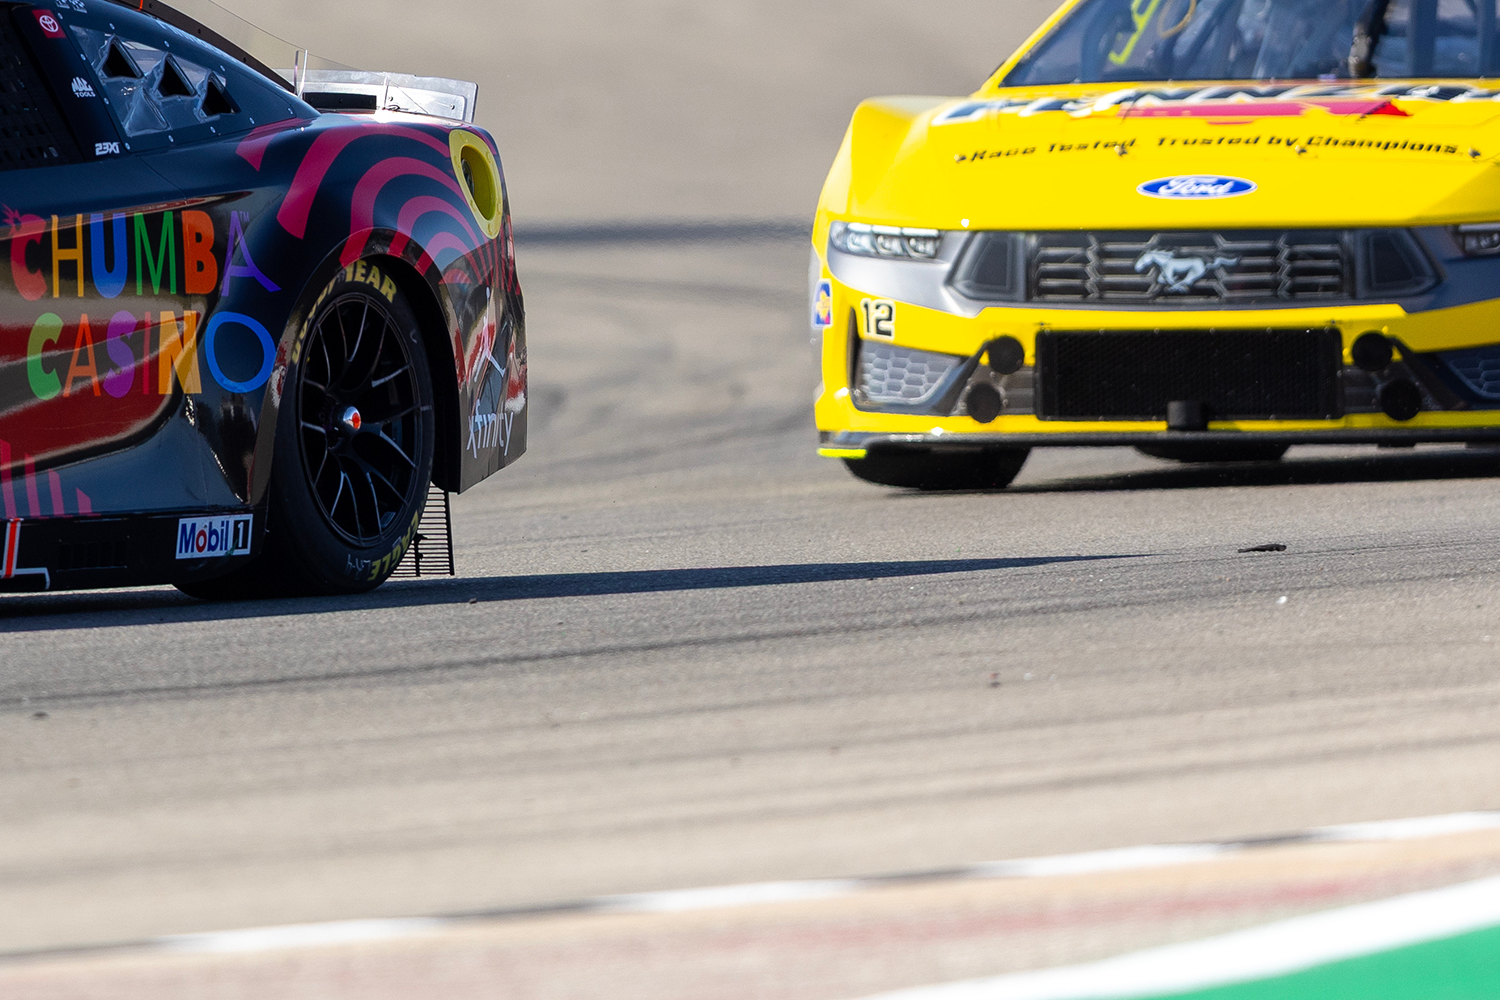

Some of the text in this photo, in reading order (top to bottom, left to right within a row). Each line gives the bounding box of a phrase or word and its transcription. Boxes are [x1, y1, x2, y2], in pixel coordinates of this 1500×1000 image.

[1267, 135, 1298, 147] by
[1157, 176, 1235, 196] Ford
[9, 208, 282, 300] CHUMBA
[861, 299, 895, 338] 12
[26, 309, 276, 401] CASINO
[466, 398, 514, 459] xfinity
[178, 520, 245, 554] Mobil 1
